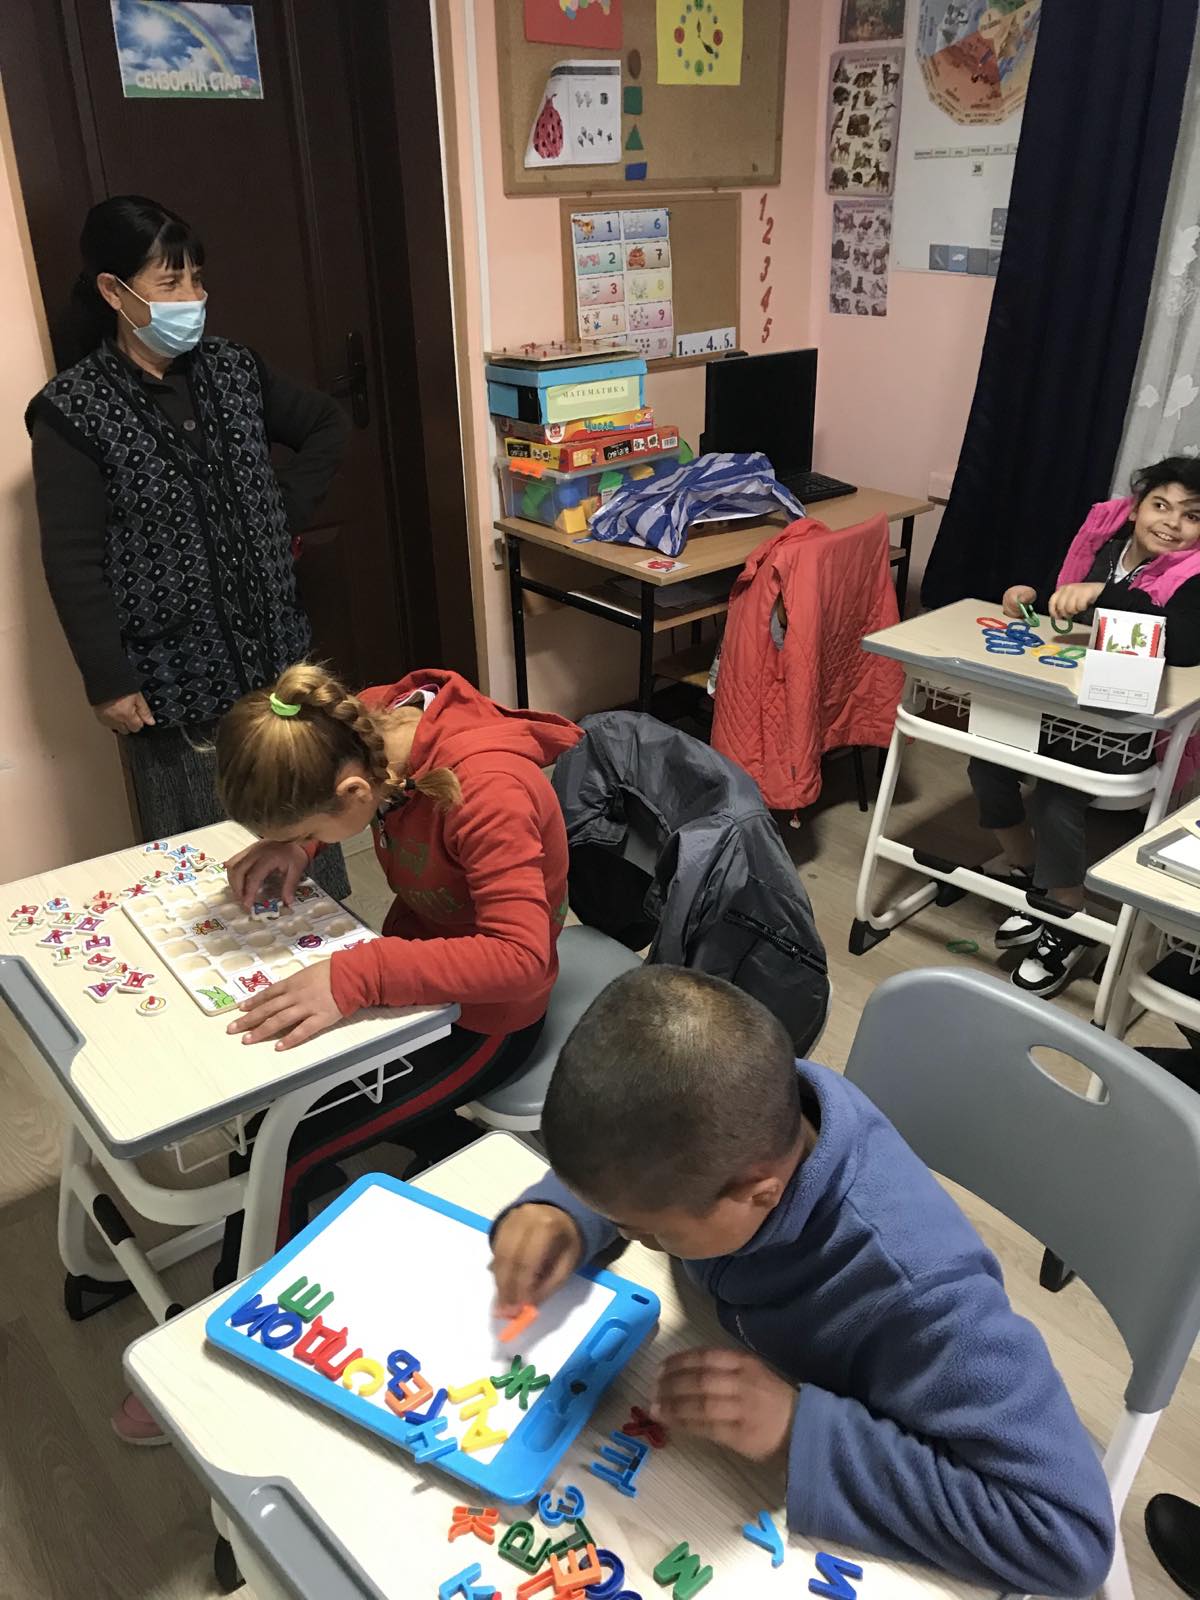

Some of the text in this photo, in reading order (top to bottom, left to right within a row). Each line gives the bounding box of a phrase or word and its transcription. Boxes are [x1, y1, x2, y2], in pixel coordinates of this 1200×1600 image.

[760, 193, 767, 221] 1
[606, 221, 613, 233] 1
[654, 218, 662, 230] 6
[762, 217, 774, 245] 2
[608, 252, 616, 265] 2
[655, 248, 663, 260] 7
[760, 256, 771, 282] 3
[610, 283, 618, 295] 3
[760, 286, 772, 313] 4
[612, 313, 619, 326] 4
[658, 309, 665, 321] 9
[762, 318, 773, 343] 5
[562, 386, 626, 398] МАТЕМАТИКА
[260, 1311, 302, 1350] О
[490, 1355, 551, 1411] Ж
